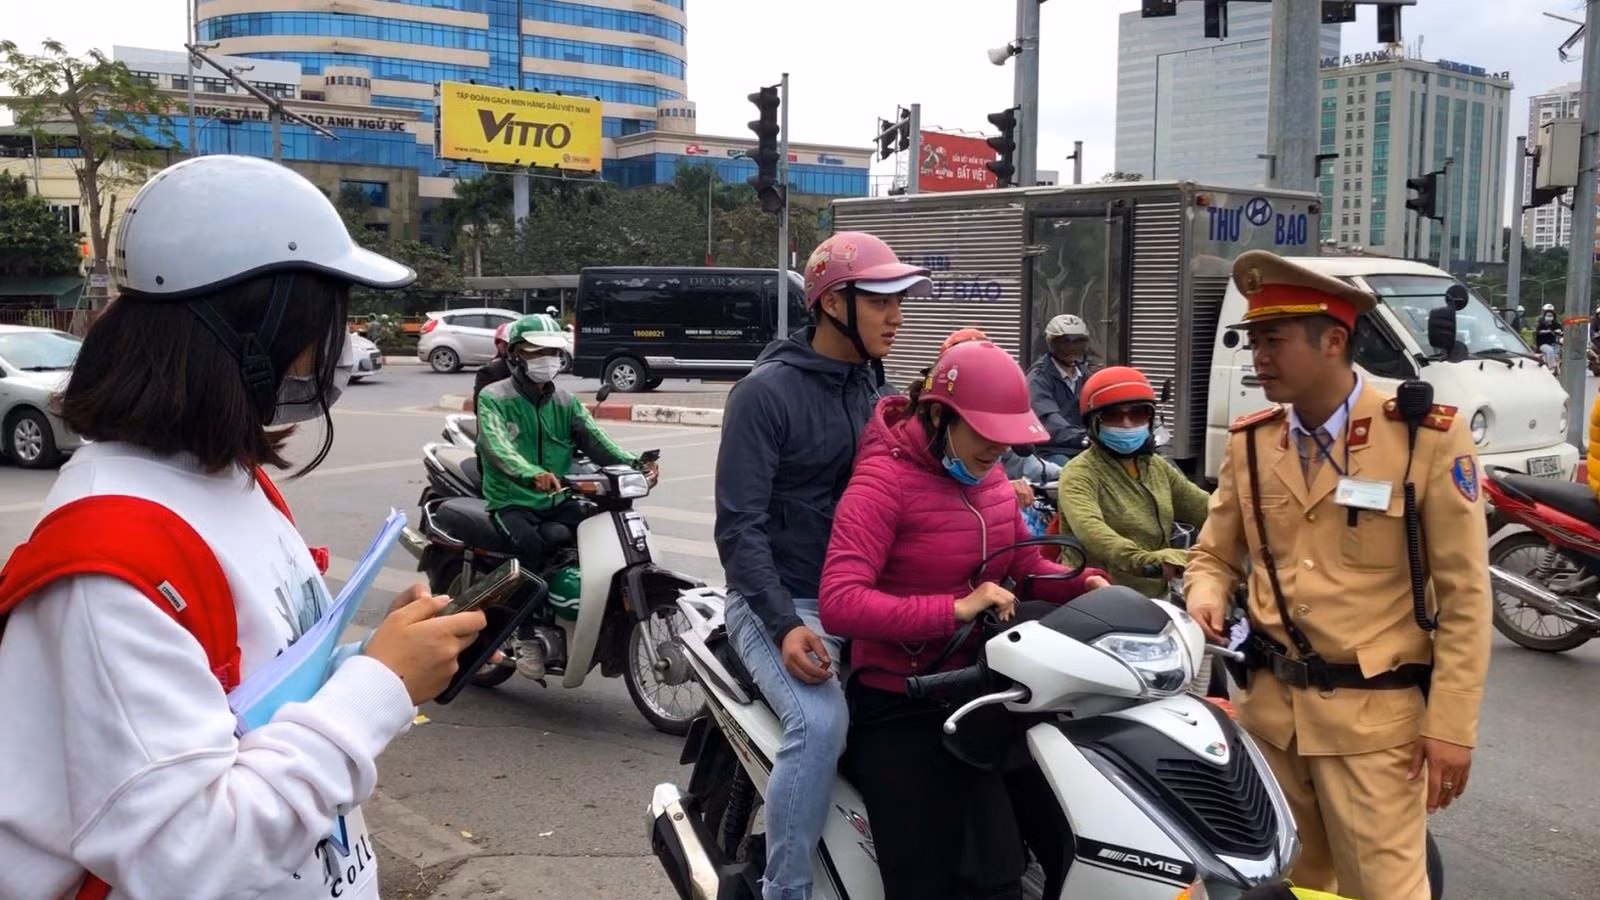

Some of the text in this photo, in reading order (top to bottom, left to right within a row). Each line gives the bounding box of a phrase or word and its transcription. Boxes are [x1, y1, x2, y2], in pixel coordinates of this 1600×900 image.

[1343, 55, 1351, 66] A
[1355, 49, 1390, 64] BANK
[327, 116, 353, 127] ANH
[1207, 205, 1307, 245] THƯ BẢO
[1122, 853, 1184, 875] AMG
